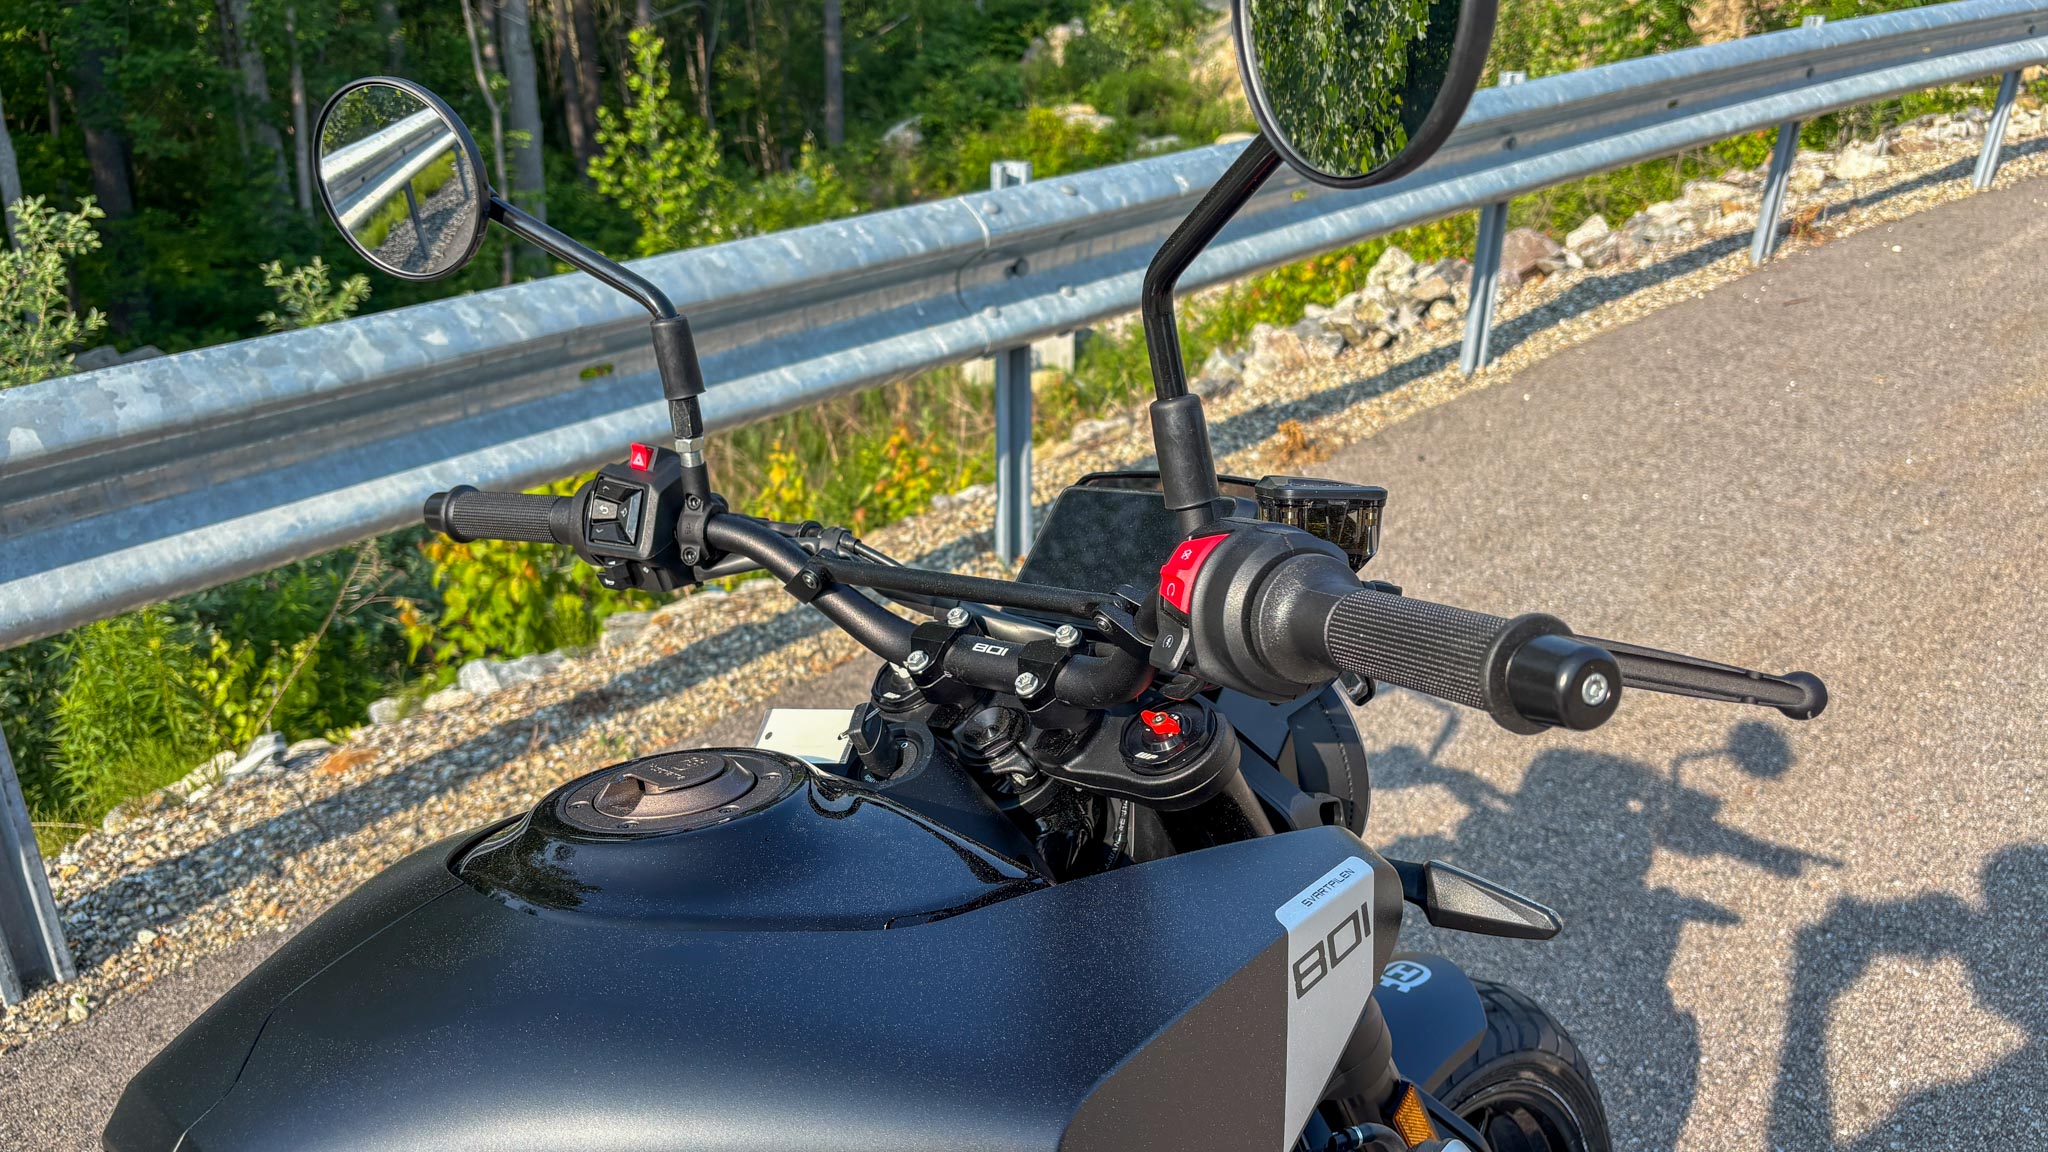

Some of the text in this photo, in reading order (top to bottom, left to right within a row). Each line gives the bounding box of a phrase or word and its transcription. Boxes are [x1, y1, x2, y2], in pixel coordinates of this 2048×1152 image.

[972, 643, 1009, 657] 801
[1301, 868, 1355, 907] SVARTPILEN
[1292, 902, 1371, 1000] 801
